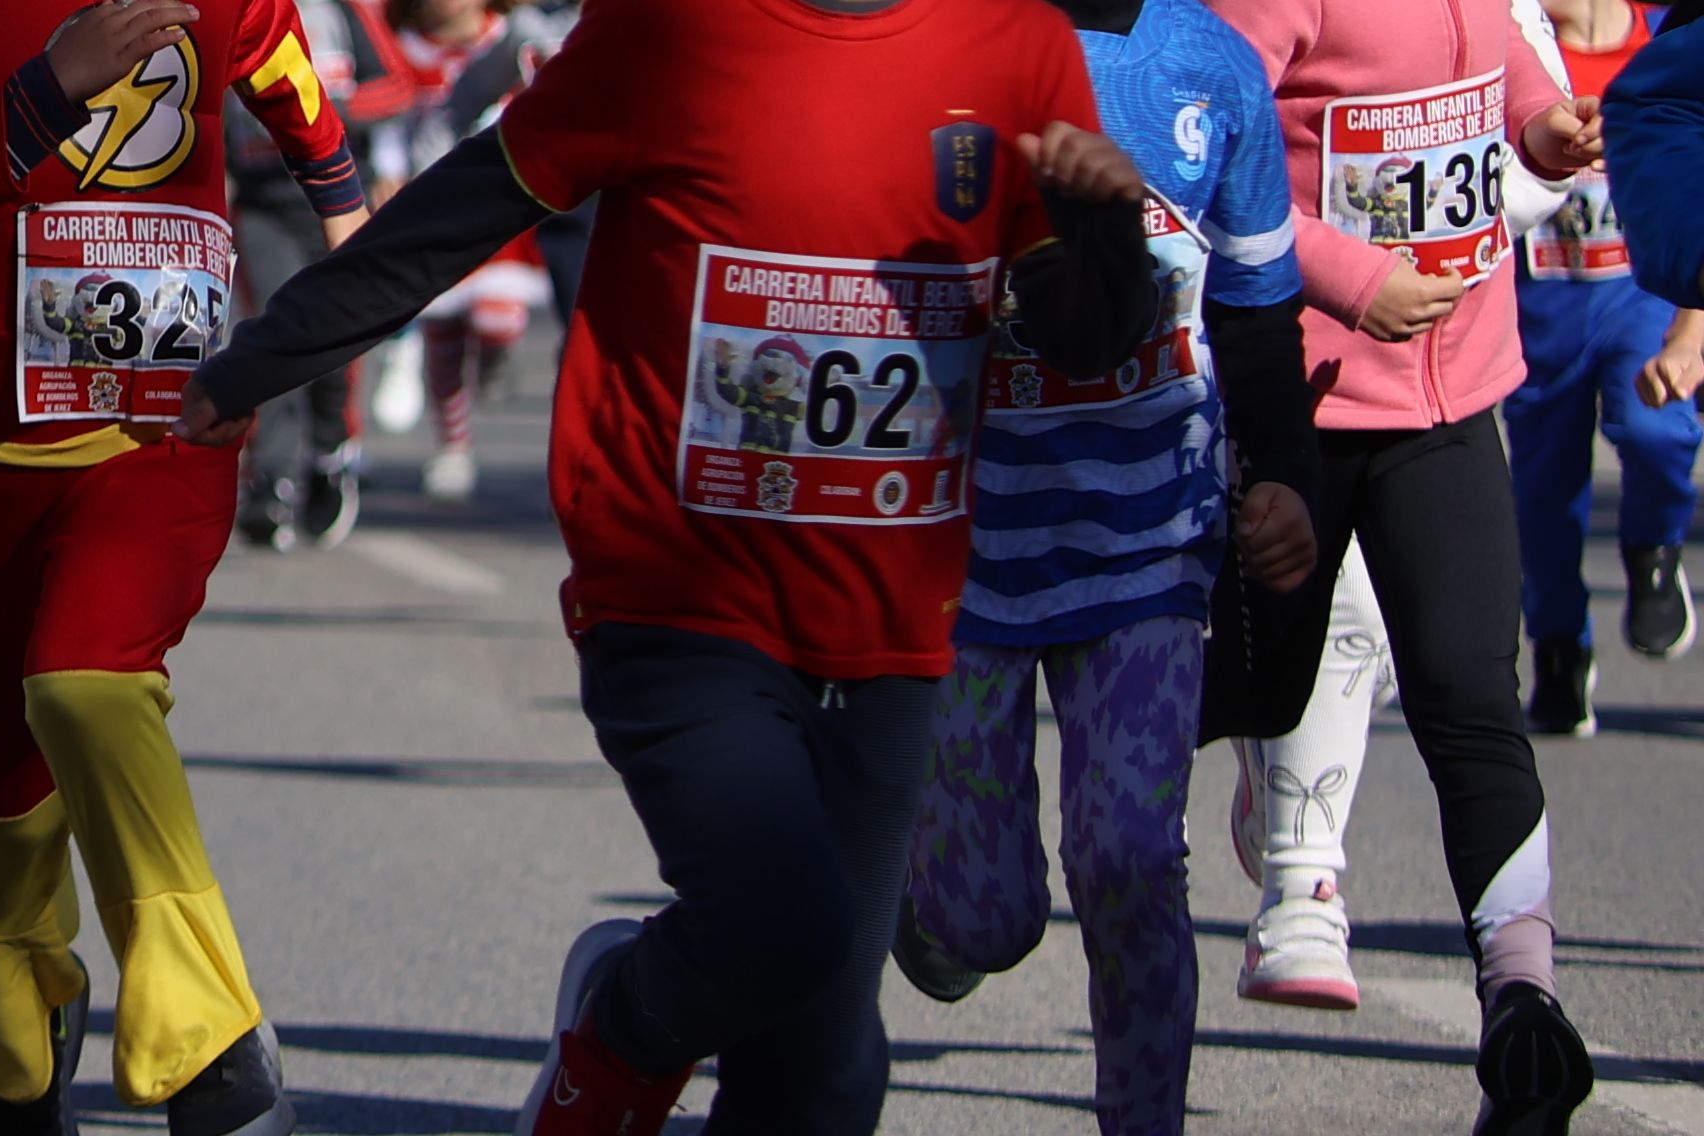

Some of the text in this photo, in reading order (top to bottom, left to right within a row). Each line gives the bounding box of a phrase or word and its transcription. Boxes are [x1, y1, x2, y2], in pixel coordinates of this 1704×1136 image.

[1347, 103, 1423, 131] CARRERA
[1426, 90, 1483, 124] INFANTIL
[1383, 117, 1464, 152] BOMBEROS
[1466, 112, 1482, 137] DE
[1396, 141, 1501, 233] 136
[43, 215, 128, 241] CARRERA
[132, 217, 203, 245] INFANTIL
[83, 242, 226, 280] BOMBEROS DE JEREZ
[724, 265, 824, 301] CARRERA
[829, 275, 918, 307] INFANTIL
[765, 300, 966, 337] BOMBEROS DE JEREZ
[805, 349, 920, 450] 62
